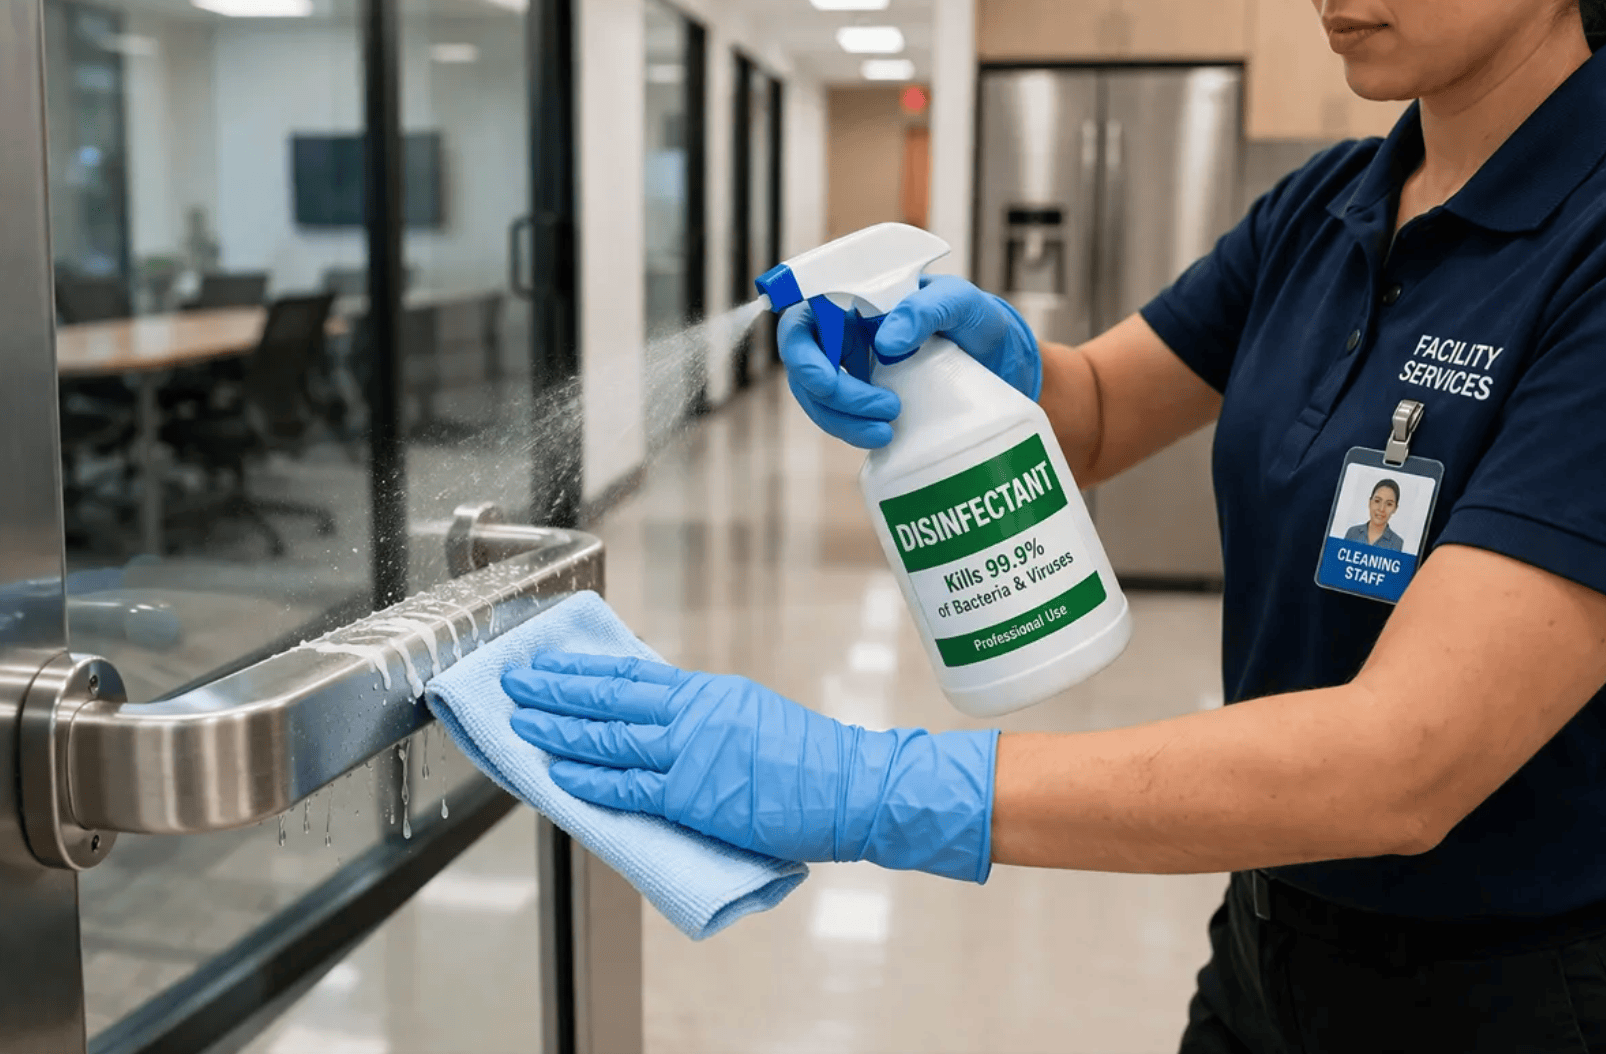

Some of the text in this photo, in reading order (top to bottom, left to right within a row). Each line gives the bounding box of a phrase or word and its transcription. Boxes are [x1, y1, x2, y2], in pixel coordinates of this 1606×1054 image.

[1413, 335, 1503, 370] FACILITY
[1398, 360, 1493, 400] SERVICES
[896, 461, 1053, 552] DISINFECTANT
[944, 538, 1045, 593] Kills 99.9%
[1337, 548, 1401, 573] CLEANING
[1344, 566, 1385, 586] STAFF
[938, 552, 1074, 618] of Bacteria & Viruses
[973, 605, 1068, 651] Professional Use
